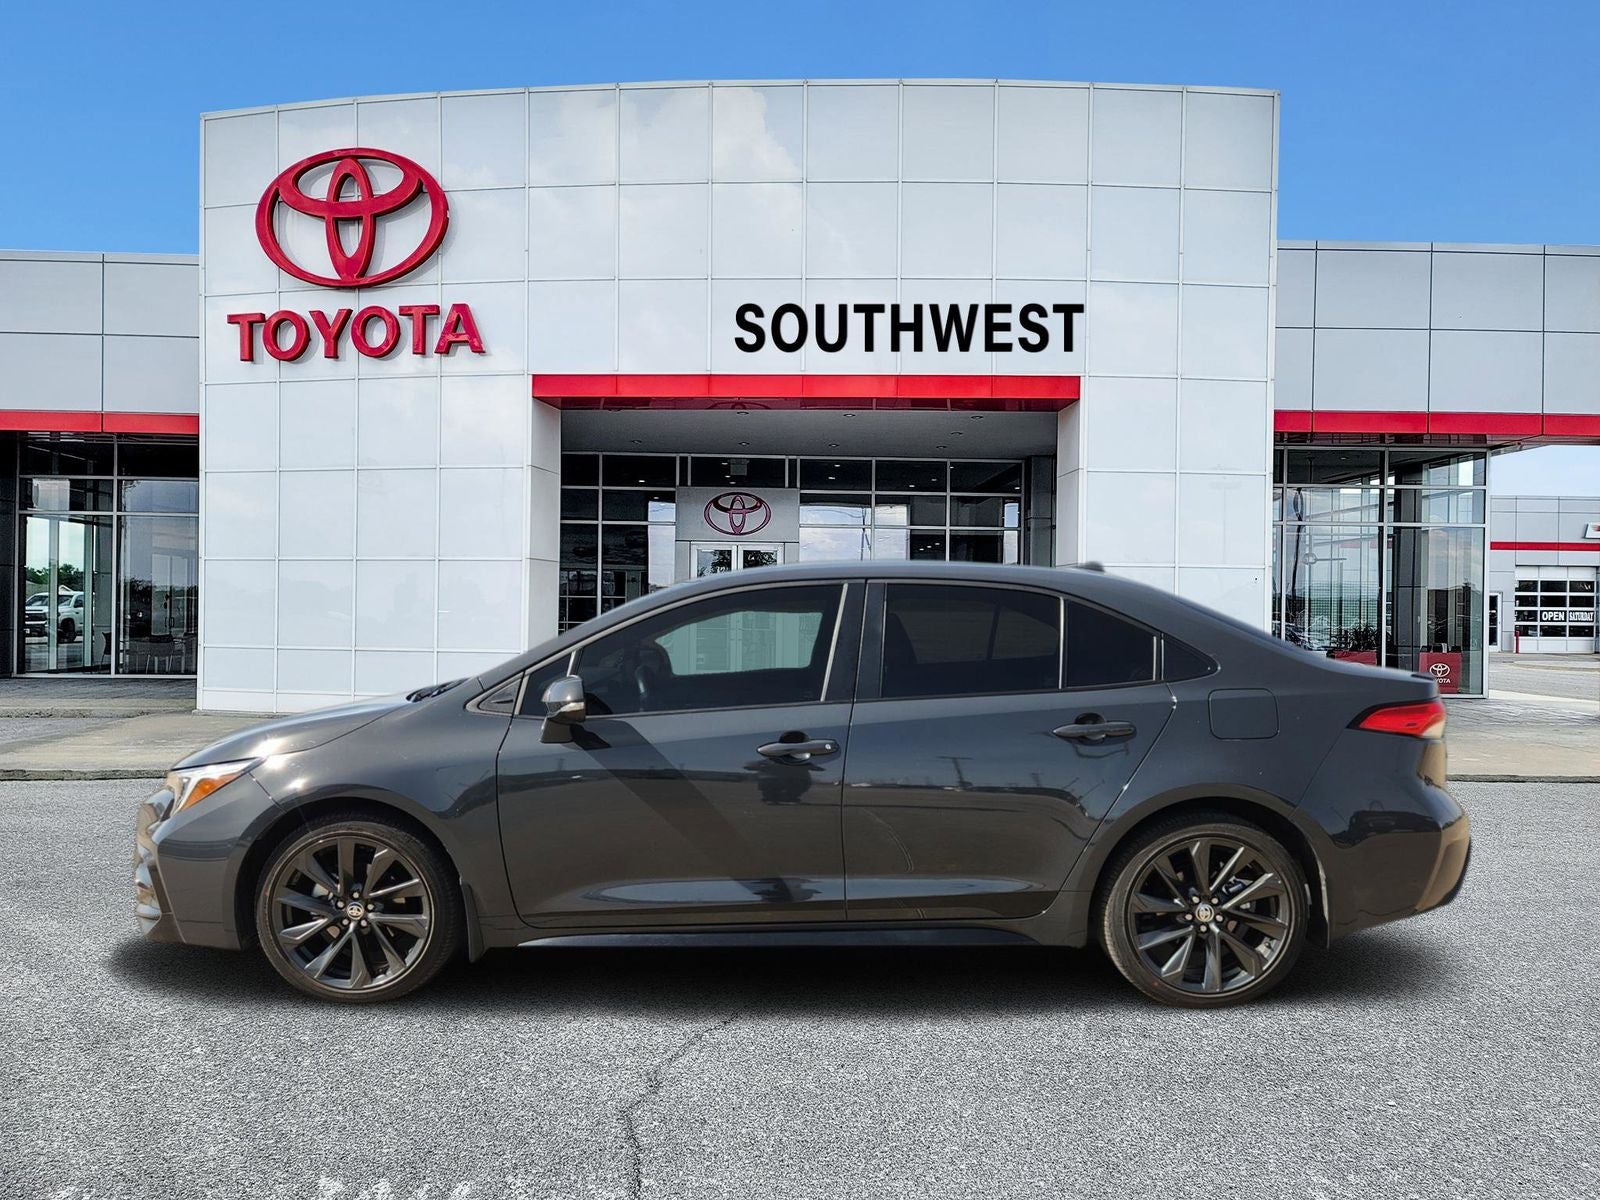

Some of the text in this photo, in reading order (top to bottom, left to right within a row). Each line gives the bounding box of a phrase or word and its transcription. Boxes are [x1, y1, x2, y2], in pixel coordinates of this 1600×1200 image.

[227, 303, 486, 362] TOYOTA
[734, 303, 1085, 353] SOUTHWEST
[1541, 611, 1594, 621] OPEN SATURDAY
